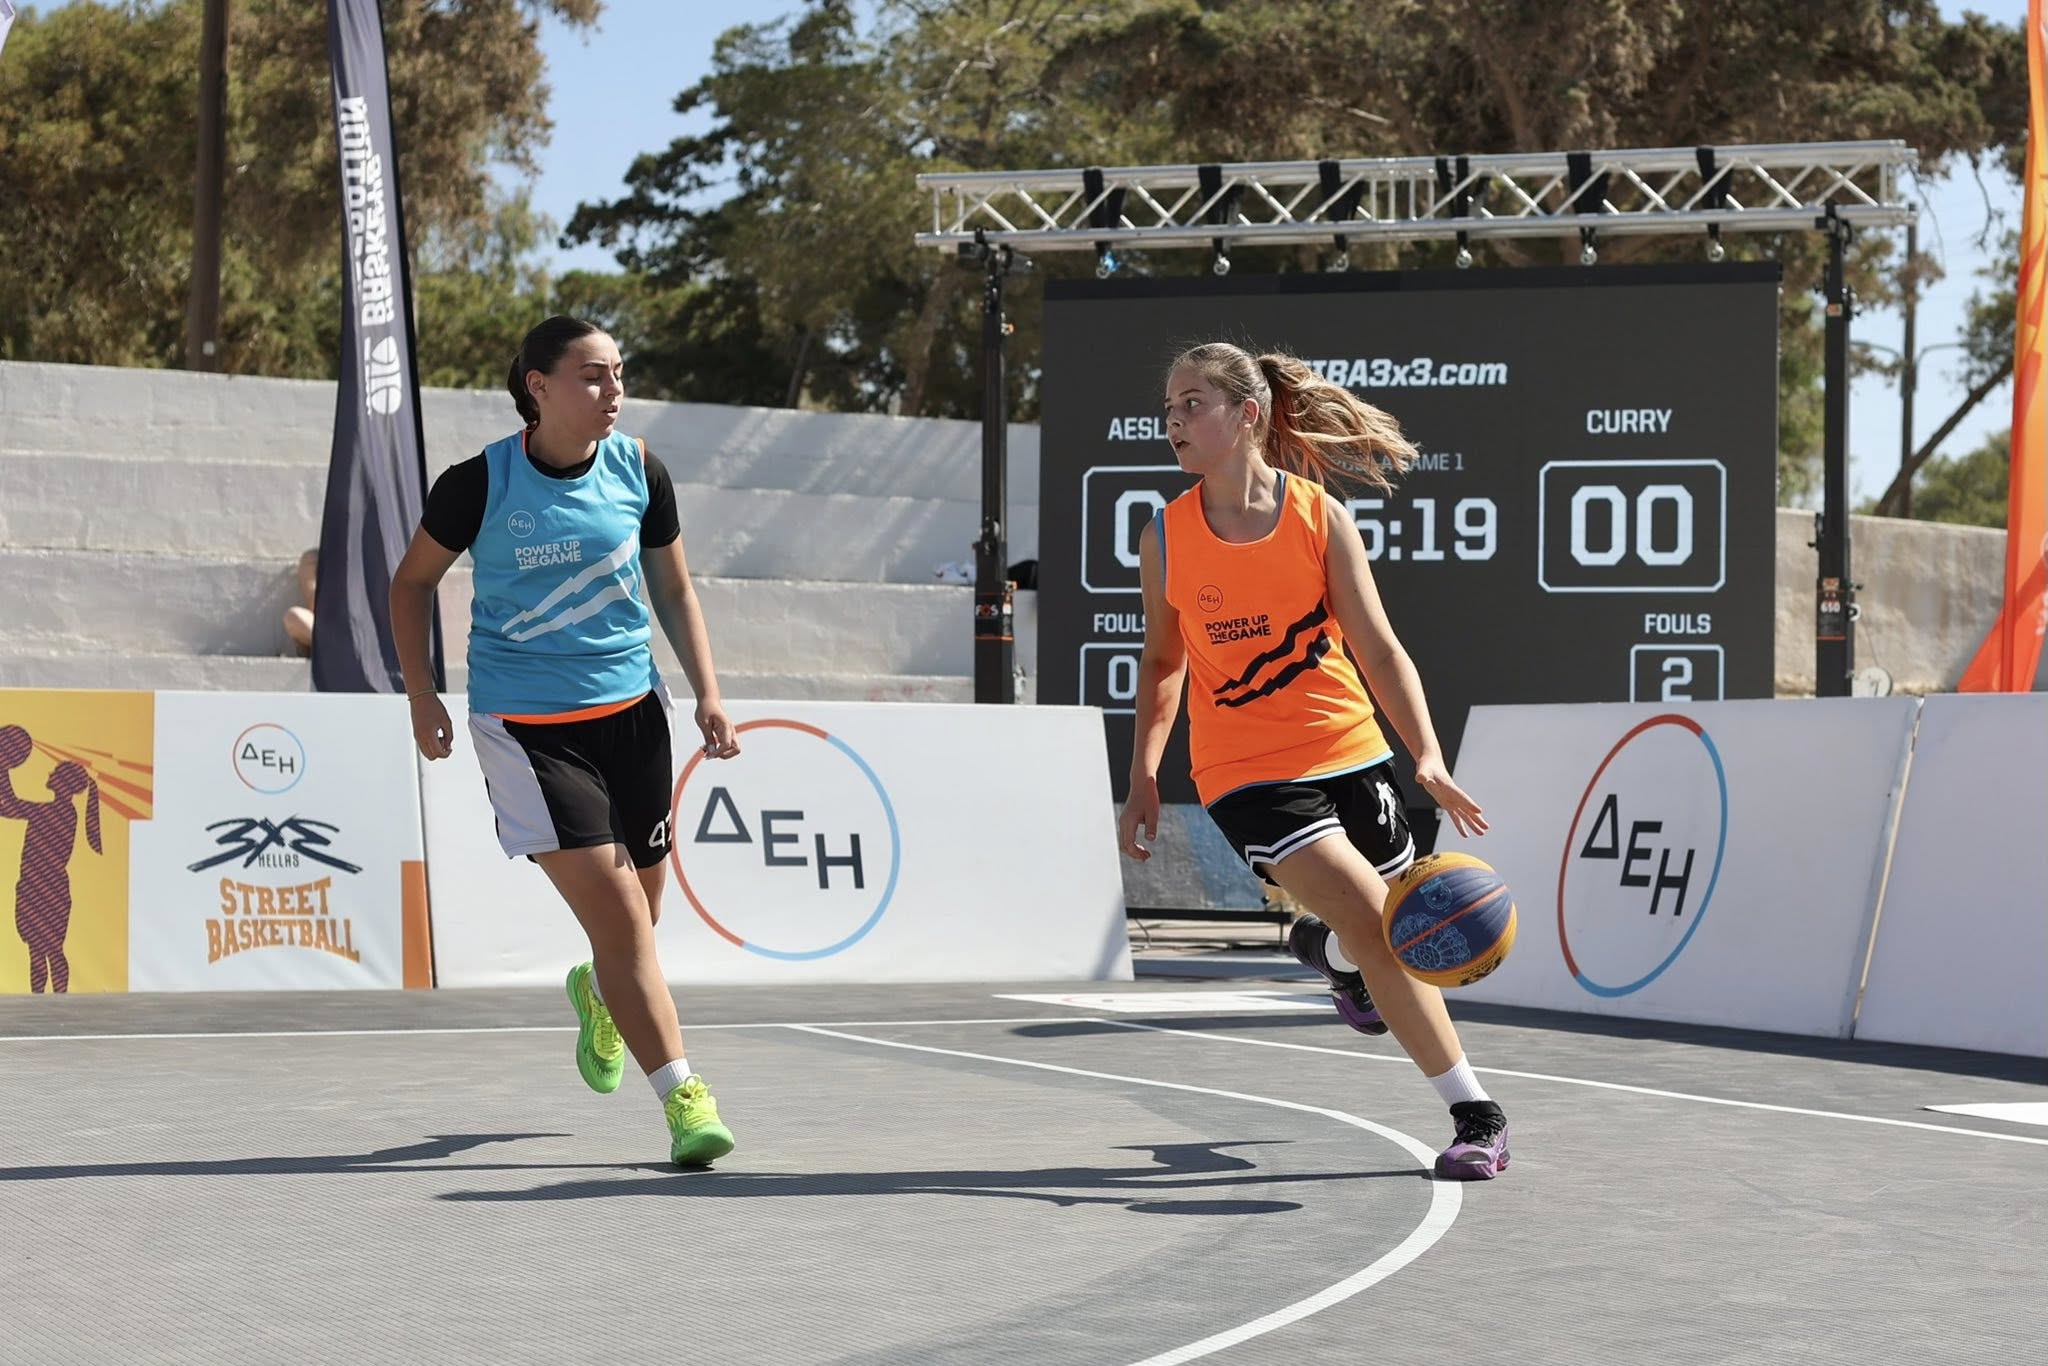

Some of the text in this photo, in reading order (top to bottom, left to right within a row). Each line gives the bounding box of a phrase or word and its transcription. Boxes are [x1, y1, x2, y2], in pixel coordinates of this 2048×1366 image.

[1107, 416, 1169, 440] AESL
[1586, 409, 1673, 434] CURRY
[1407, 453, 1451, 471] AME
[1455, 453, 1464, 471] 1
[1571, 485, 1693, 566] 00
[515, 540, 581, 558] POWER UP
[516, 550, 582, 566] THE GAME
[1205, 614, 1269, 632] POWER UP
[1208, 624, 1272, 641] THE GAME
[1644, 614, 1712, 634] FOULS
[1662, 657, 1693, 702] 2
[241, 743, 294, 774] ΔΕΗ
[694, 786, 865, 889] ΔΕΗ
[258, 852, 300, 869] HELLAS
[1580, 794, 1696, 916] ΔΕΗ
[219, 876, 332, 916] STREET
[205, 918, 361, 965] BASKETBALL
